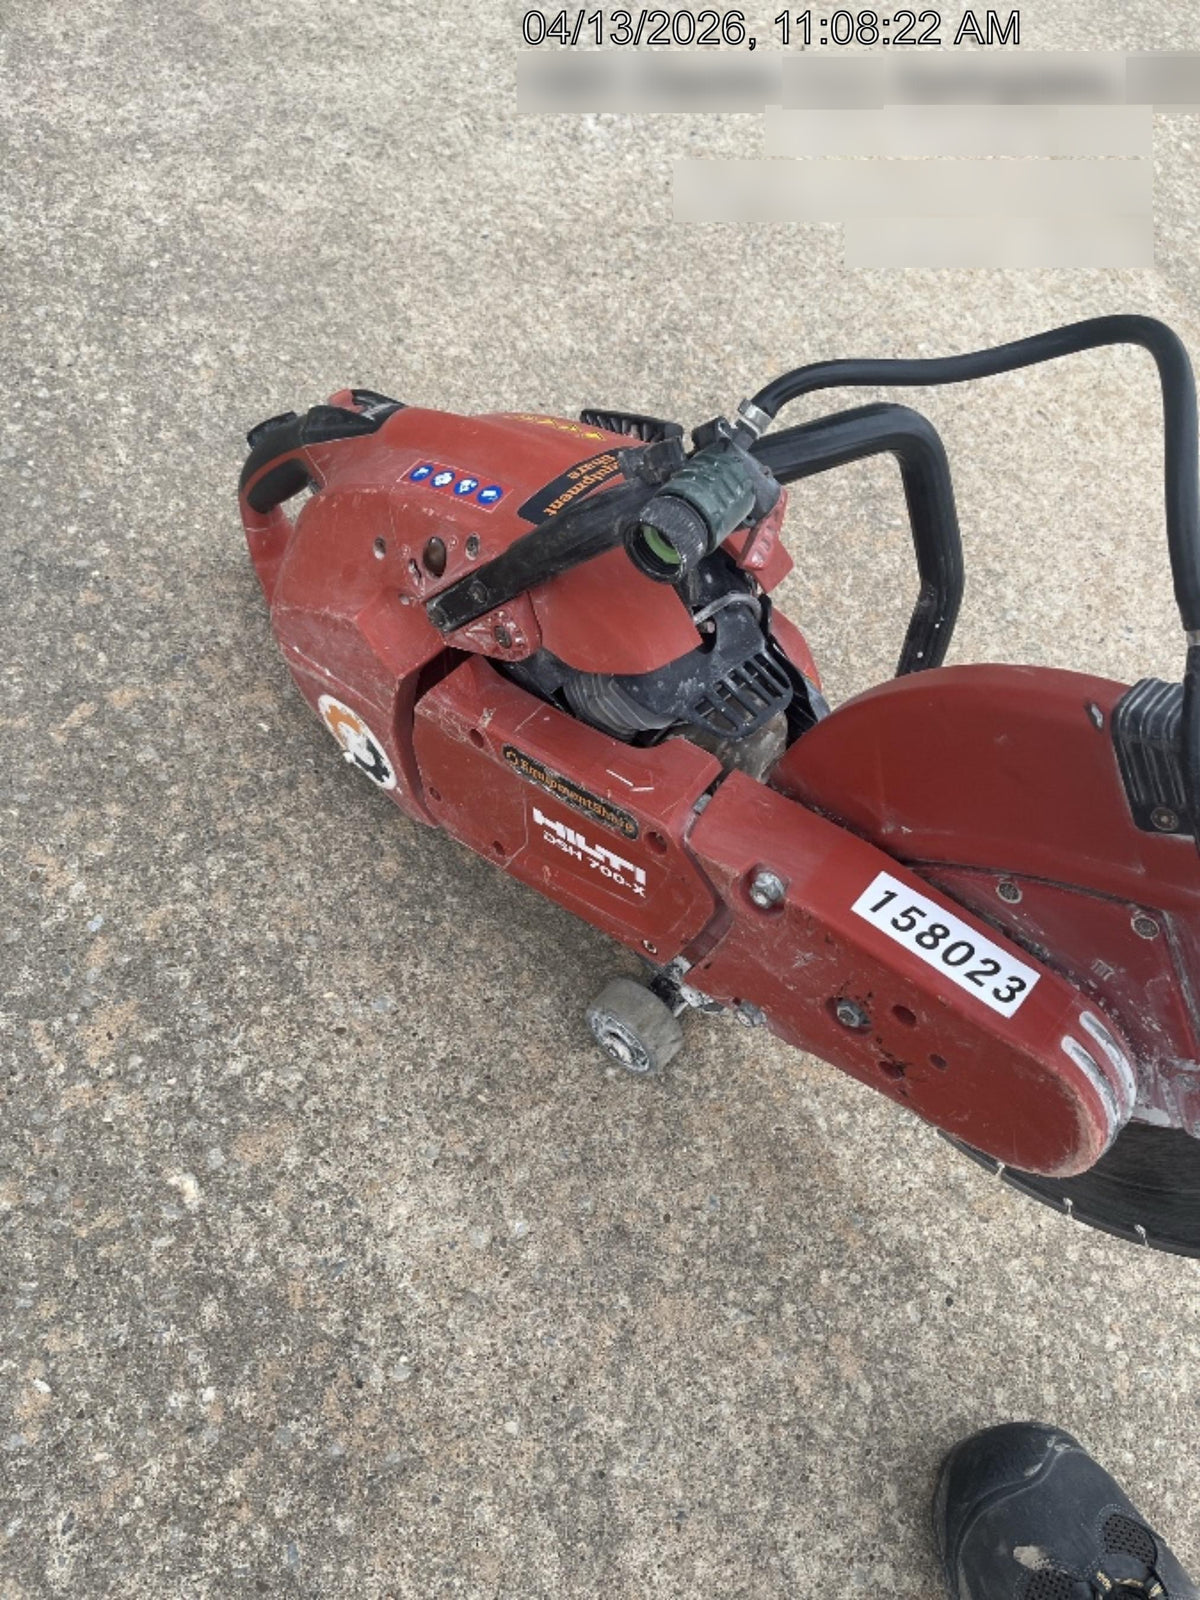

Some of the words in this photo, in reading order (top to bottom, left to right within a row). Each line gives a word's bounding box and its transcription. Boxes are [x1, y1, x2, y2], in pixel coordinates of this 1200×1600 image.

[532, 806, 647, 886] HILTI
[543, 829, 583, 862] DSH
[869, 890, 1027, 1004] 158023
